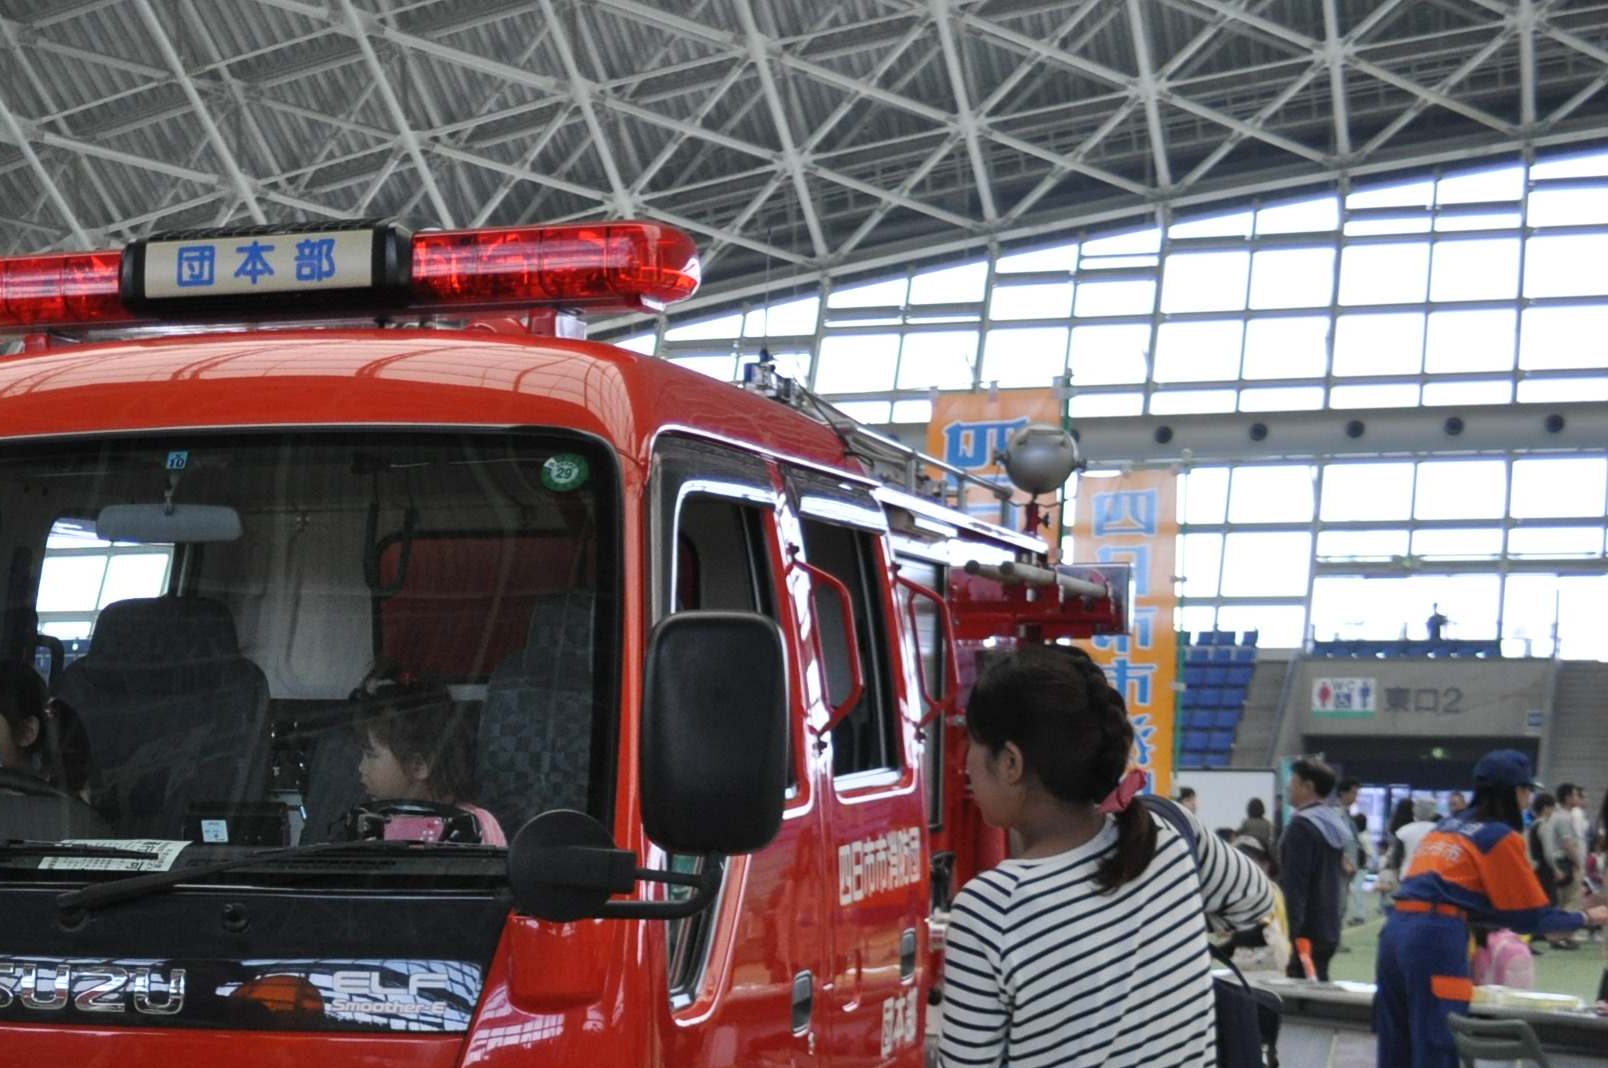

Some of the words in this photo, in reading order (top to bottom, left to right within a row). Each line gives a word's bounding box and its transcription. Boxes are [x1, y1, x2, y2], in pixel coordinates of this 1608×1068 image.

[177, 238, 336, 287] 団本部
[555, 467, 573, 480] 29
[1331, 680, 1356, 691] WC
[1384, 686, 1463, 714] 東口2
[838, 826, 921, 906] 四日市市消防団
[333, 971, 449, 995] ELF
[332, 999, 448, 1015] Smoother-E
[881, 986, 918, 1058] 団本部
